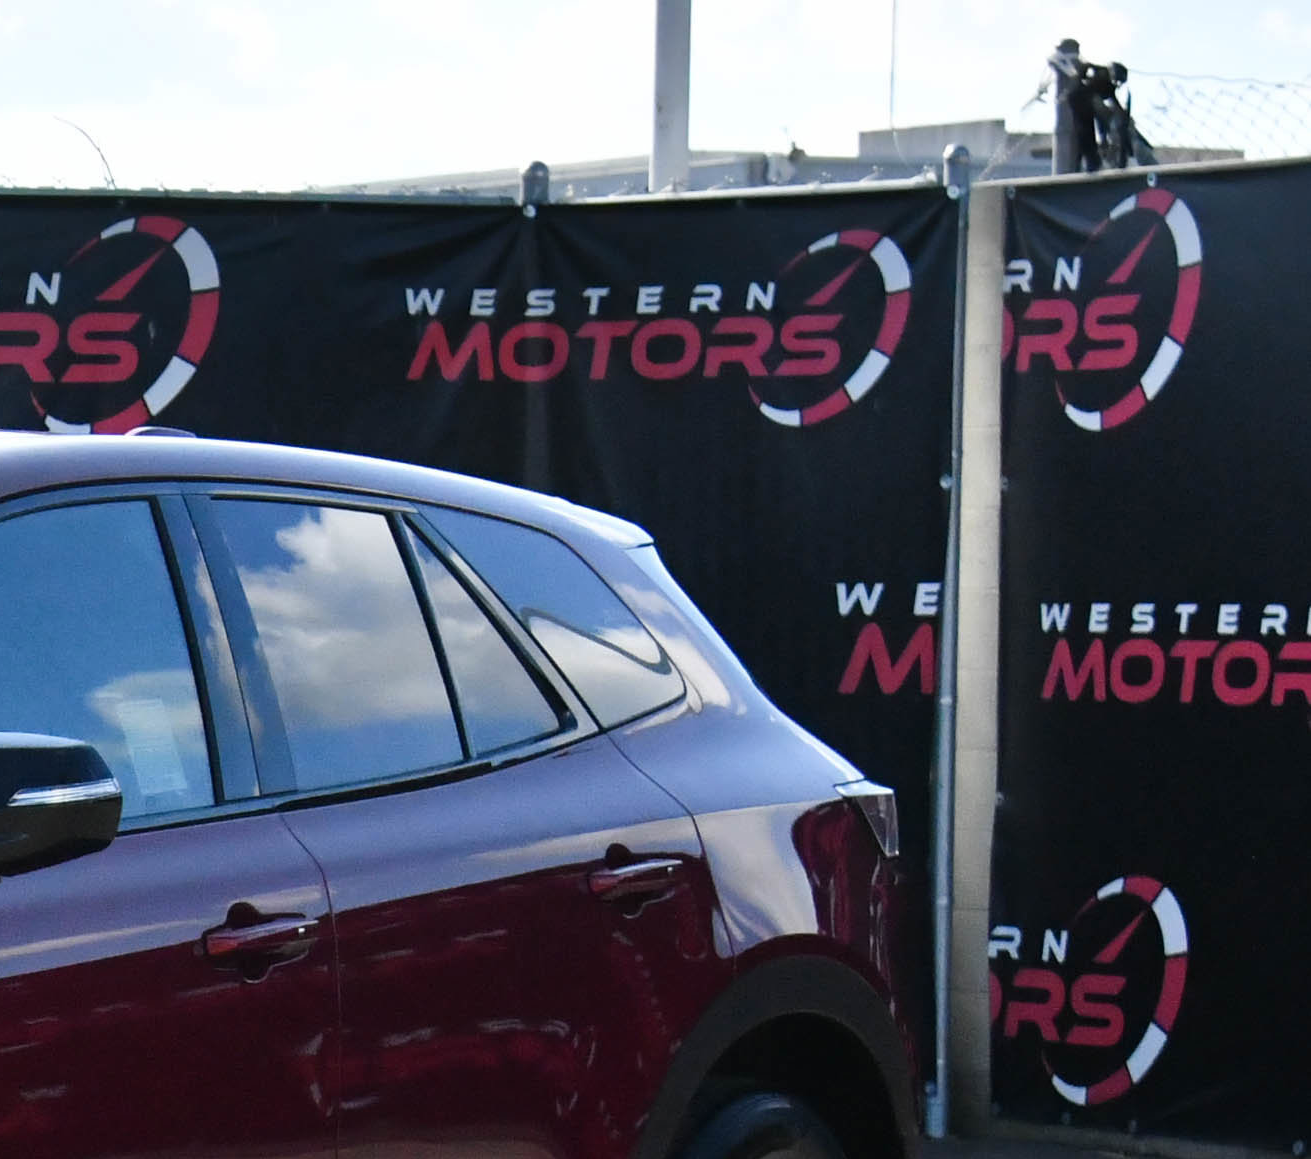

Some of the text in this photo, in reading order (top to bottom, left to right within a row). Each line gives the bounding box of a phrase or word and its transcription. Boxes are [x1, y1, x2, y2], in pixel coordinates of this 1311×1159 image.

[406, 282, 776, 316] WESTERN
[406, 311, 845, 381] MOTORS
[1040, 603, 1311, 636] WESTER
